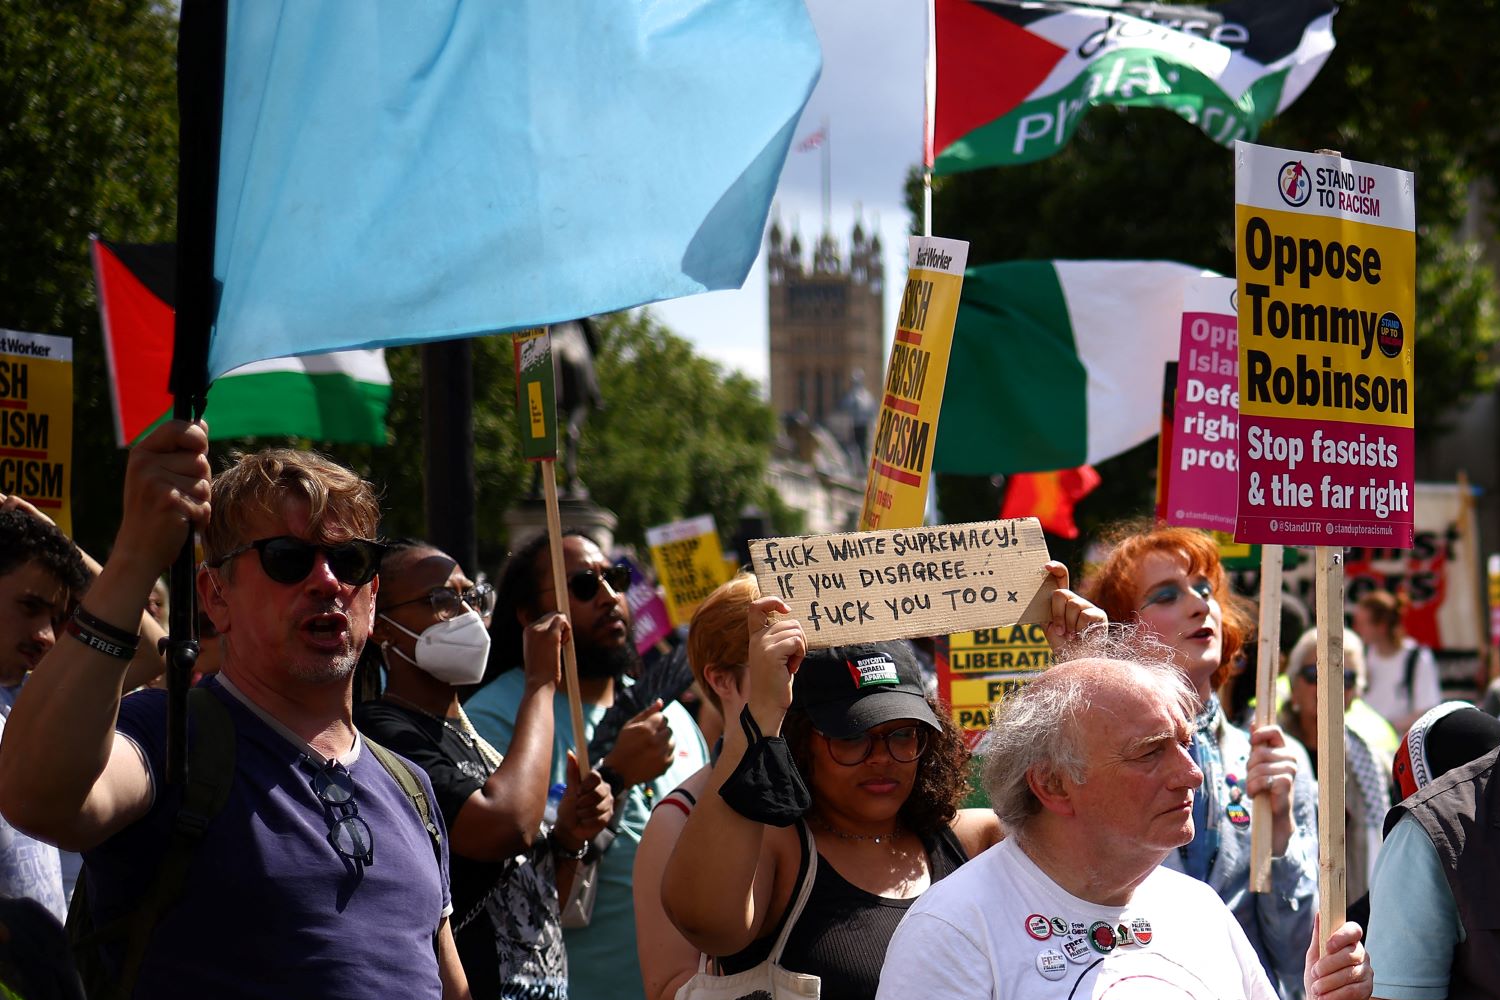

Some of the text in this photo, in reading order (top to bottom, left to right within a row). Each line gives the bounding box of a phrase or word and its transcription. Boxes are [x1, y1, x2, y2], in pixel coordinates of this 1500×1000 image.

[1316, 168, 1375, 195] STAND UP
[1317, 189, 1380, 217] TO RACISM
[1245, 216, 1382, 289] Oppose
[1245, 283, 1378, 360] Tommy
[1247, 349, 1408, 415] Robinson
[1183, 411, 1239, 443] righ
[1180, 447, 1239, 472] prot
[1247, 425, 1398, 470] Stop fascists
[1247, 471, 1409, 519] & the far right
[827, 537, 886, 562] WHITE
[892, 521, 1019, 557] SUPREMACY!
[776, 572, 795, 600] IF
[884, 592, 931, 621] YOU
[942, 586, 998, 611] TOO
[89, 636, 122, 656] FREE
[974, 624, 1045, 645] BLAC
[857, 657, 886, 666] BOYCOTT
[860, 665, 886, 673] ISRAELI
[952, 652, 1050, 671] LIBERATI
